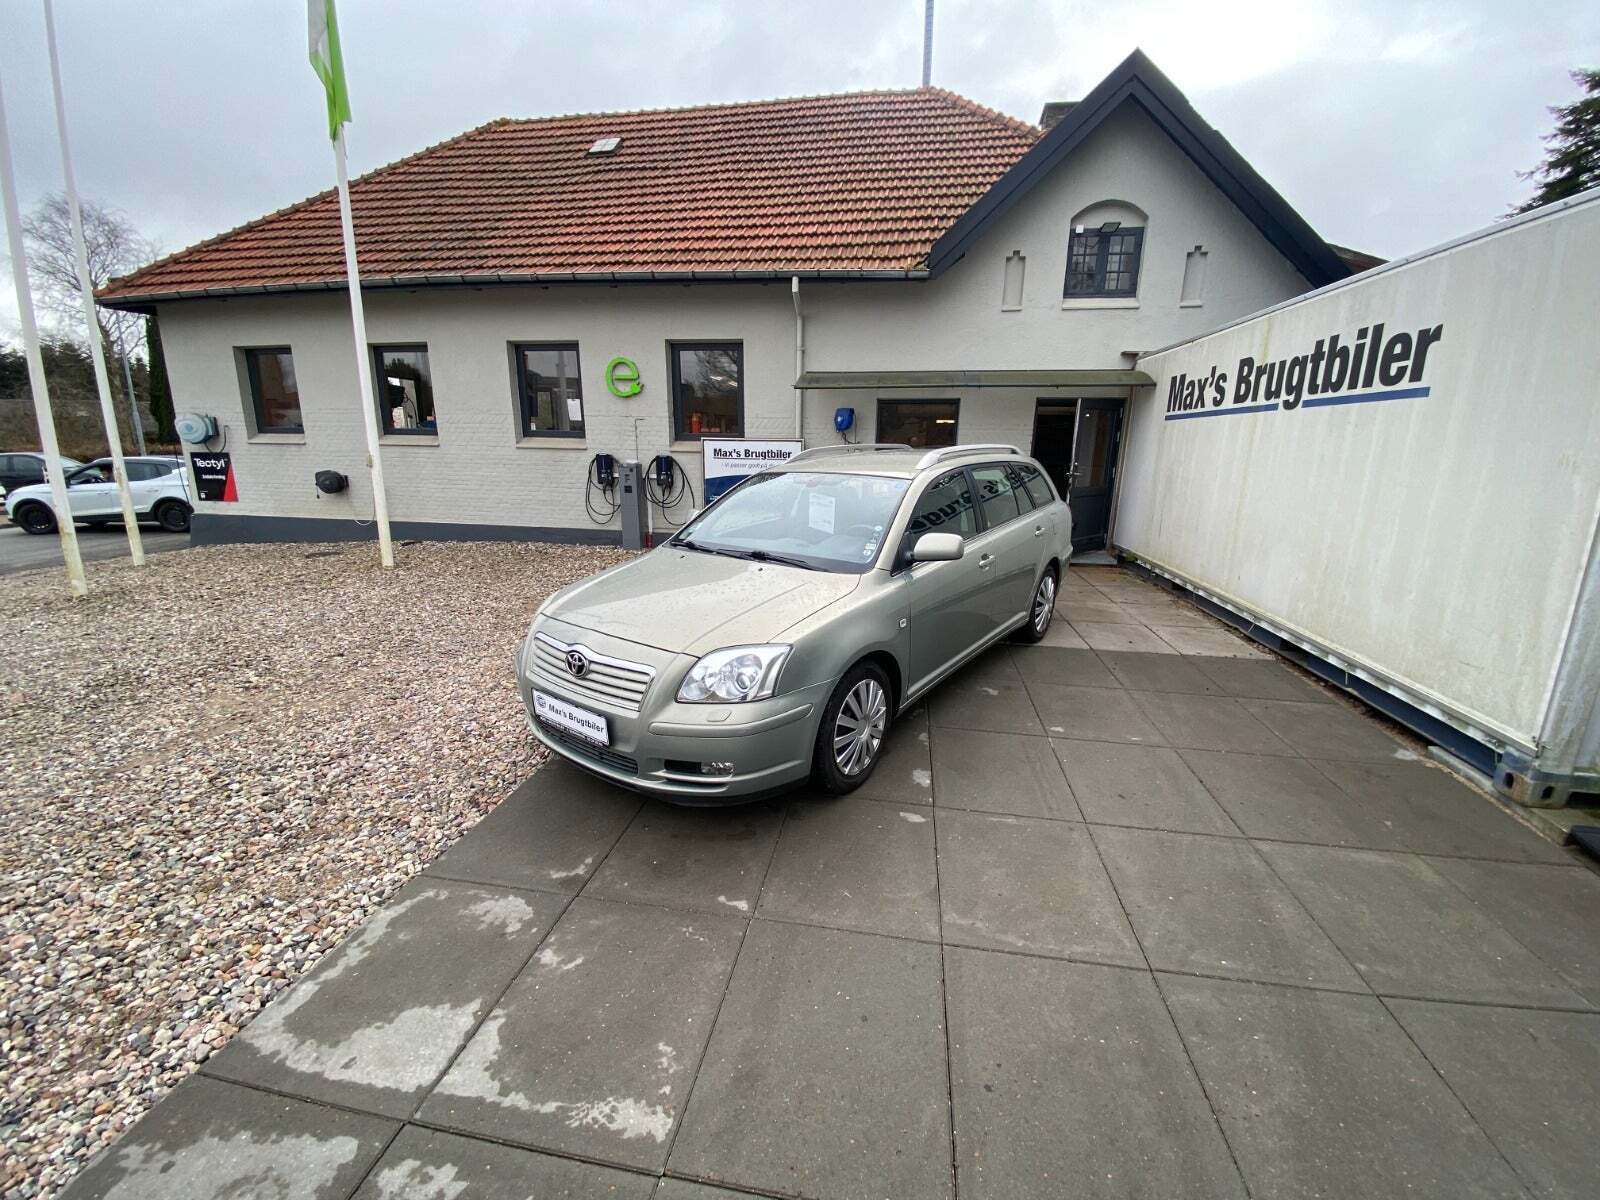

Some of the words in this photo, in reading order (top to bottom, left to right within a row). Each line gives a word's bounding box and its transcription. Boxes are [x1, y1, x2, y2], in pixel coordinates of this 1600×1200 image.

[1167, 365, 1228, 412] Max's
[1233, 322, 1444, 411] Brugtbiler
[194, 457, 225, 470] Tectyl
[713, 448, 742, 458] Max's
[744, 448, 793, 461] Brugtbiler
[548, 703, 567, 718] Max's
[568, 712, 605, 733] Brugtbiler
